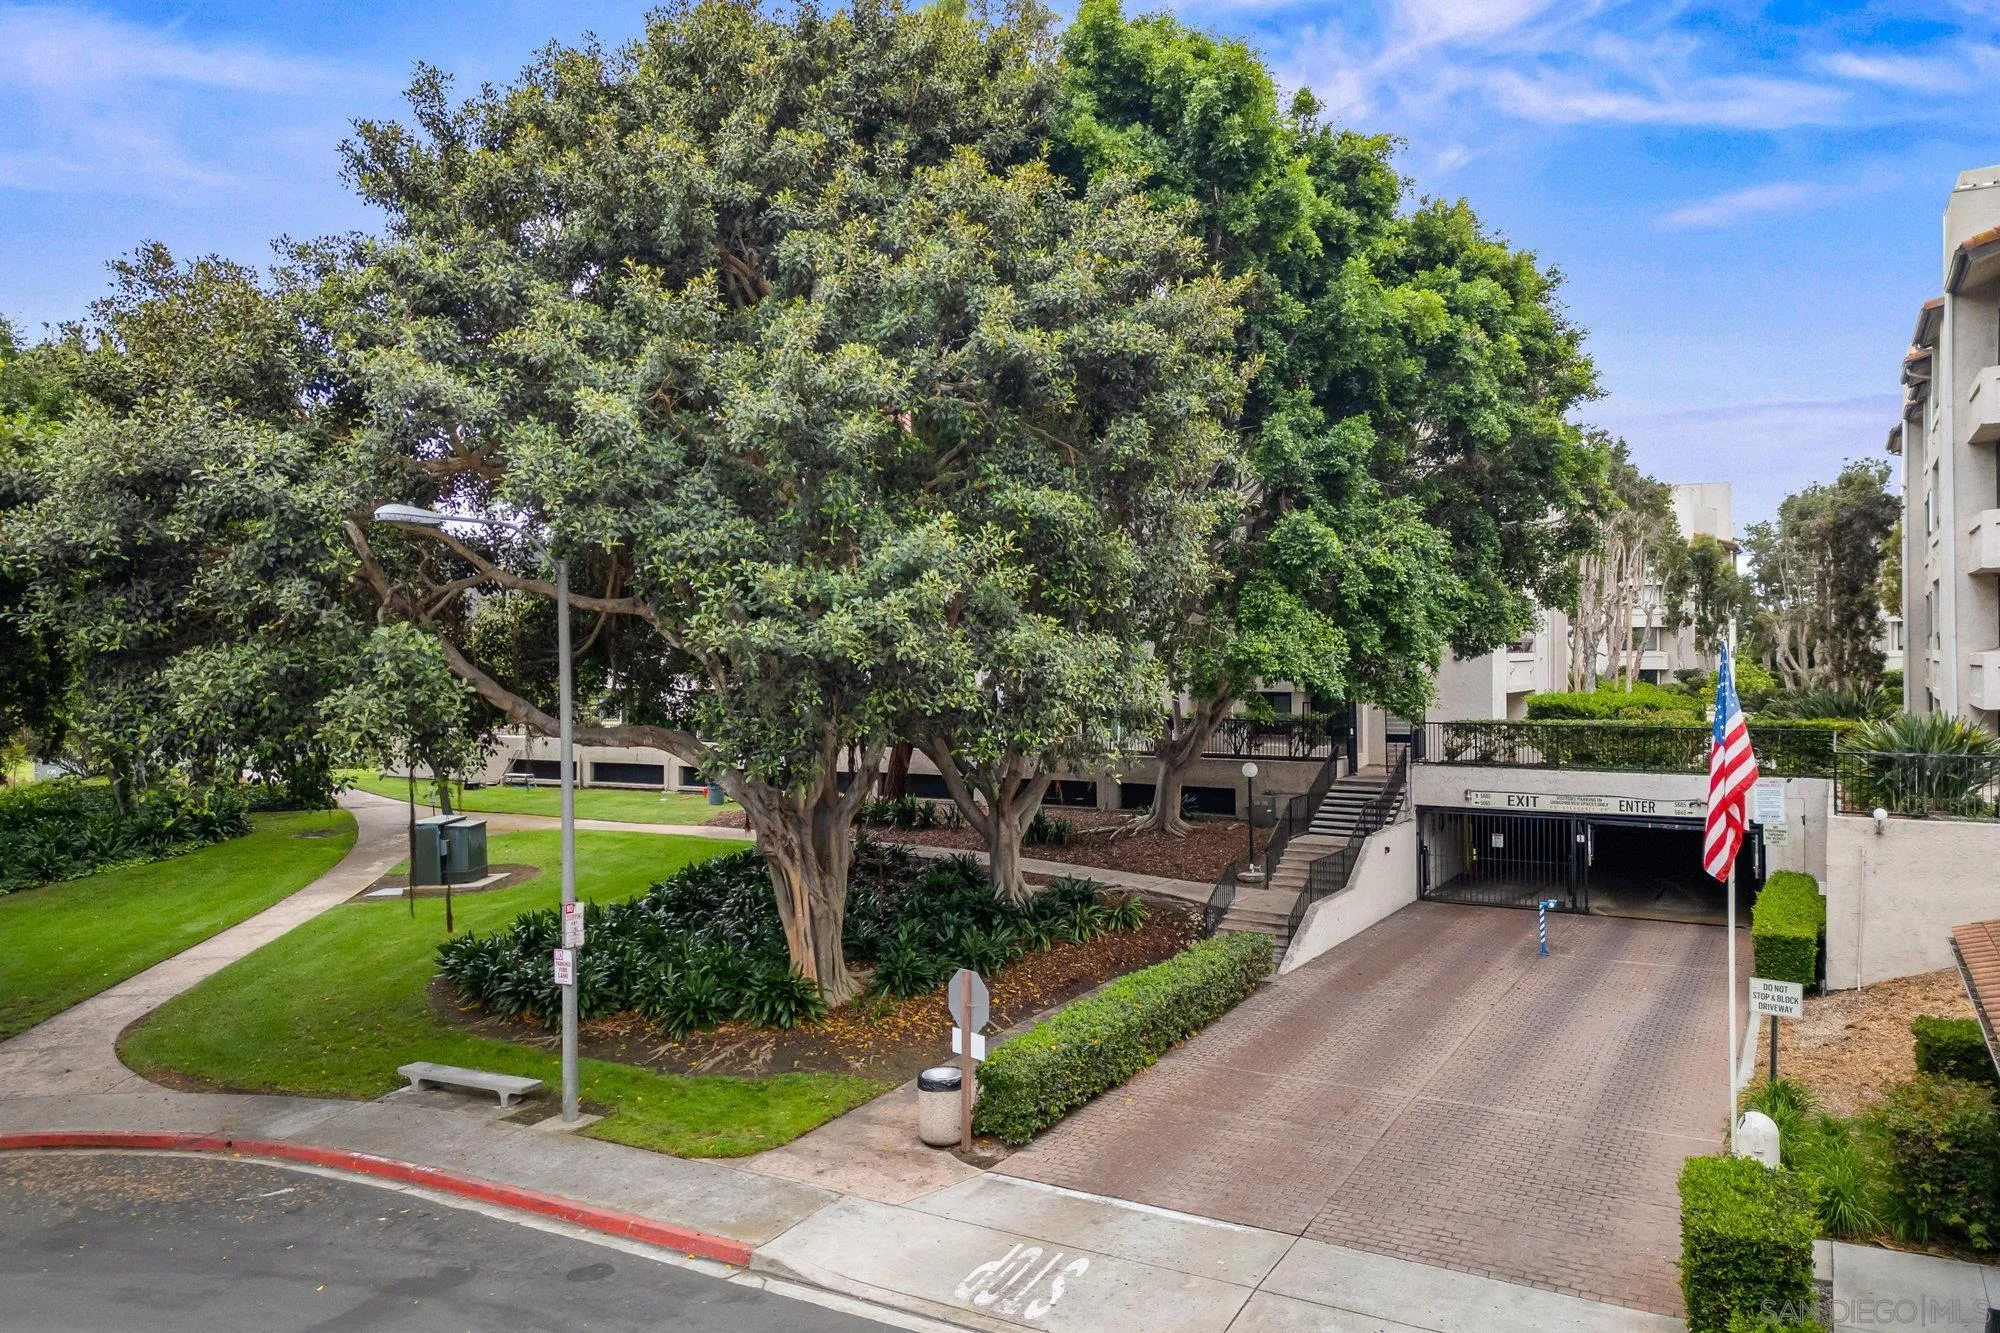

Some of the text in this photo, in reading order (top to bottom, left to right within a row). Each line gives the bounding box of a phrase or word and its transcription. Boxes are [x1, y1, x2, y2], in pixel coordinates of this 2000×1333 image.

[1507, 794, 1539, 808] EXIT
[1619, 800, 1656, 813] ENTER
[1763, 983, 1788, 993] DO NOT
[1752, 991, 1799, 1005] STOP & BLOCK
[1758, 1002, 1793, 1013] DRIVEWAY
[954, 1242, 1090, 1320] STOP
